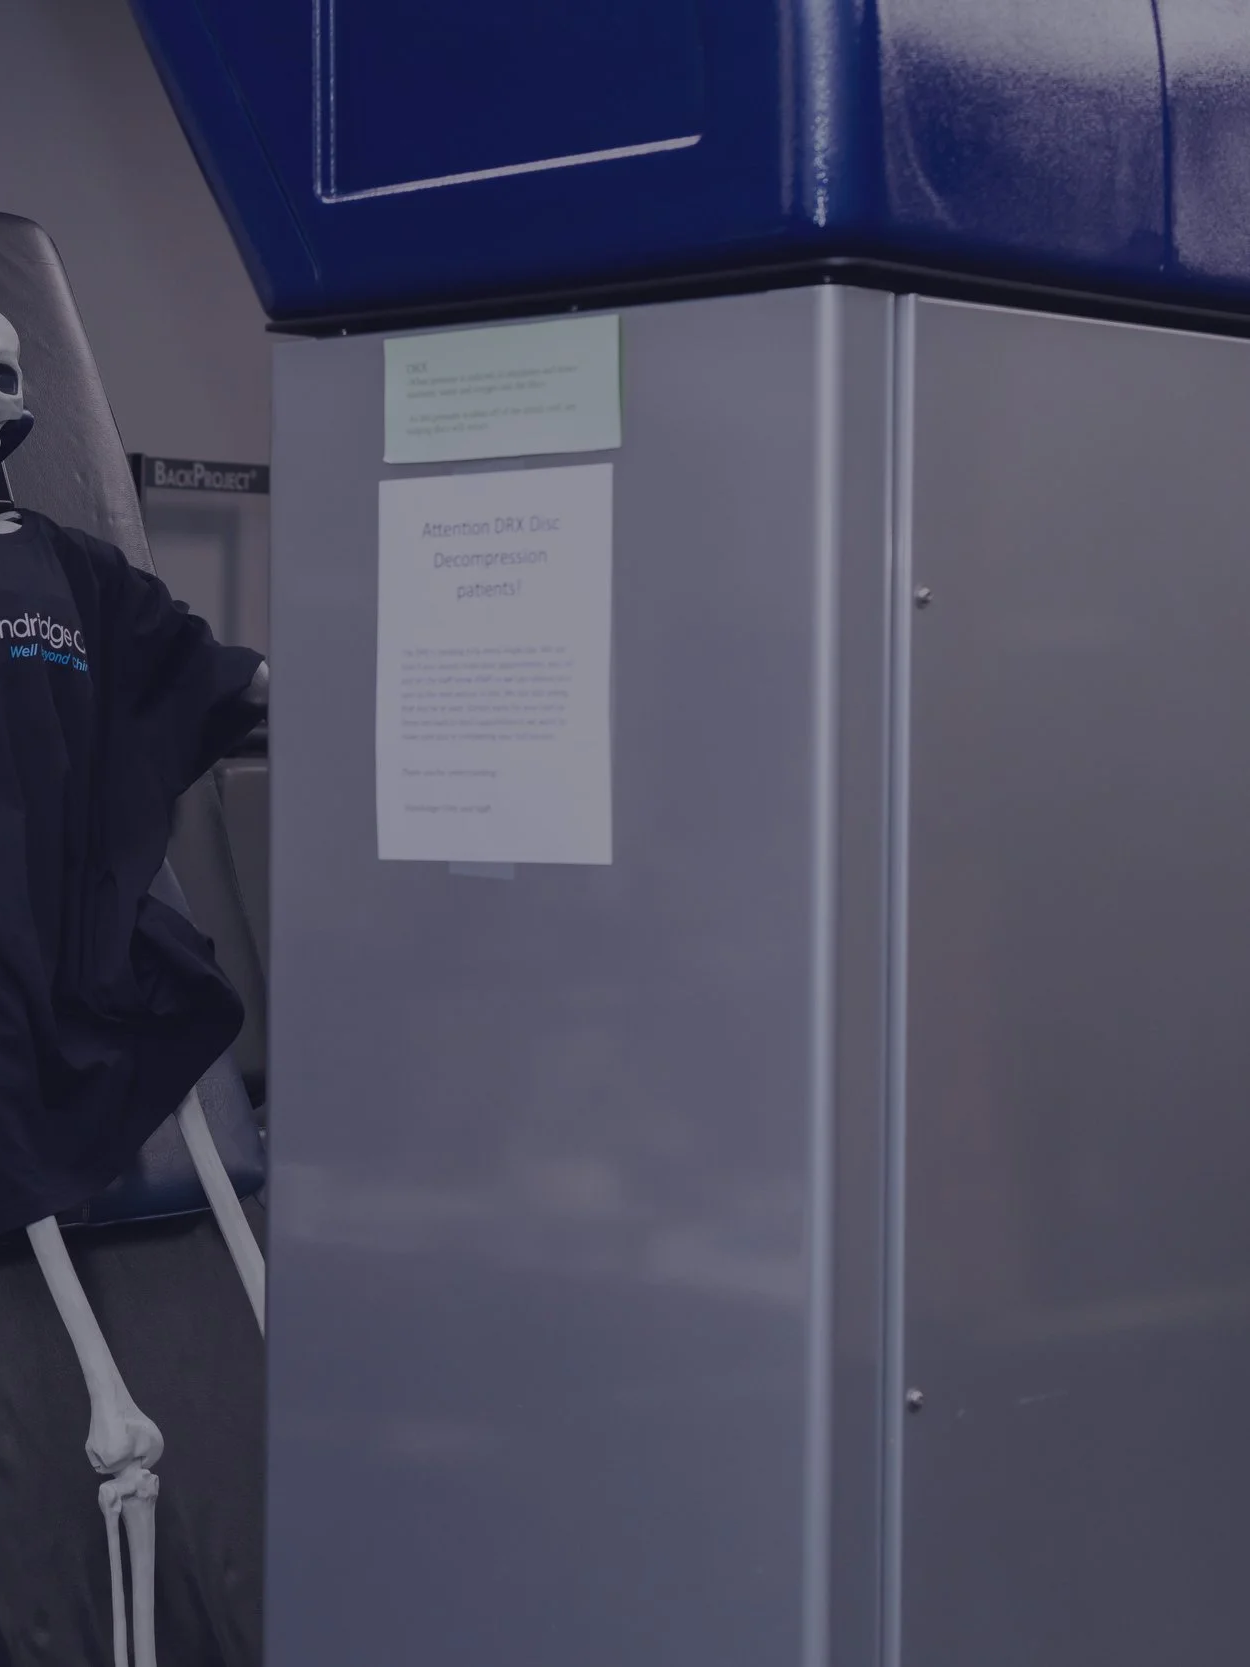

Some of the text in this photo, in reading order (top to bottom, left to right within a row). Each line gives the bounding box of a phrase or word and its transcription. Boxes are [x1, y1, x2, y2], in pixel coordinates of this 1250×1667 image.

[422, 515, 561, 538] Attention DRX Disc
[433, 550, 548, 569] Decompression
[10, 644, 38, 658] Well
